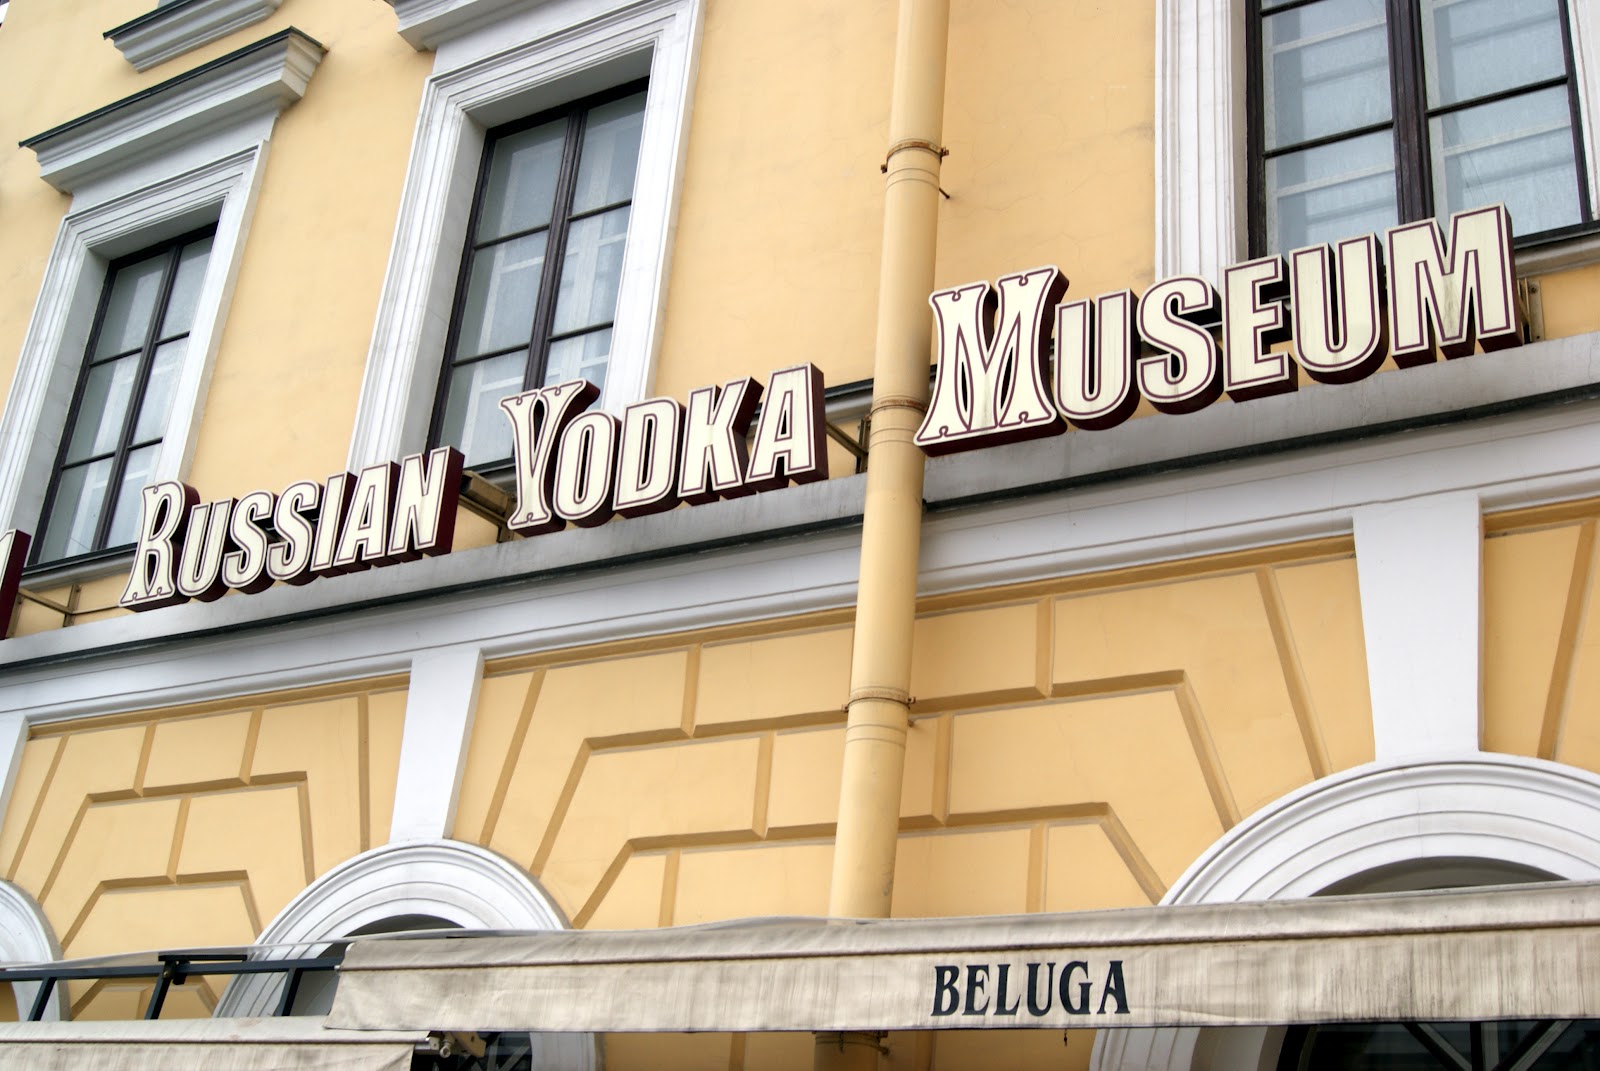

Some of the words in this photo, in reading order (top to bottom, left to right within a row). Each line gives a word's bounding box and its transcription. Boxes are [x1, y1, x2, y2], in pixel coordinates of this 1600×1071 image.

[119, 446, 461, 607] RUSSIAN
[914, 202, 1521, 453] MUSEUM
[930, 960, 1131, 1017] BELUGA
